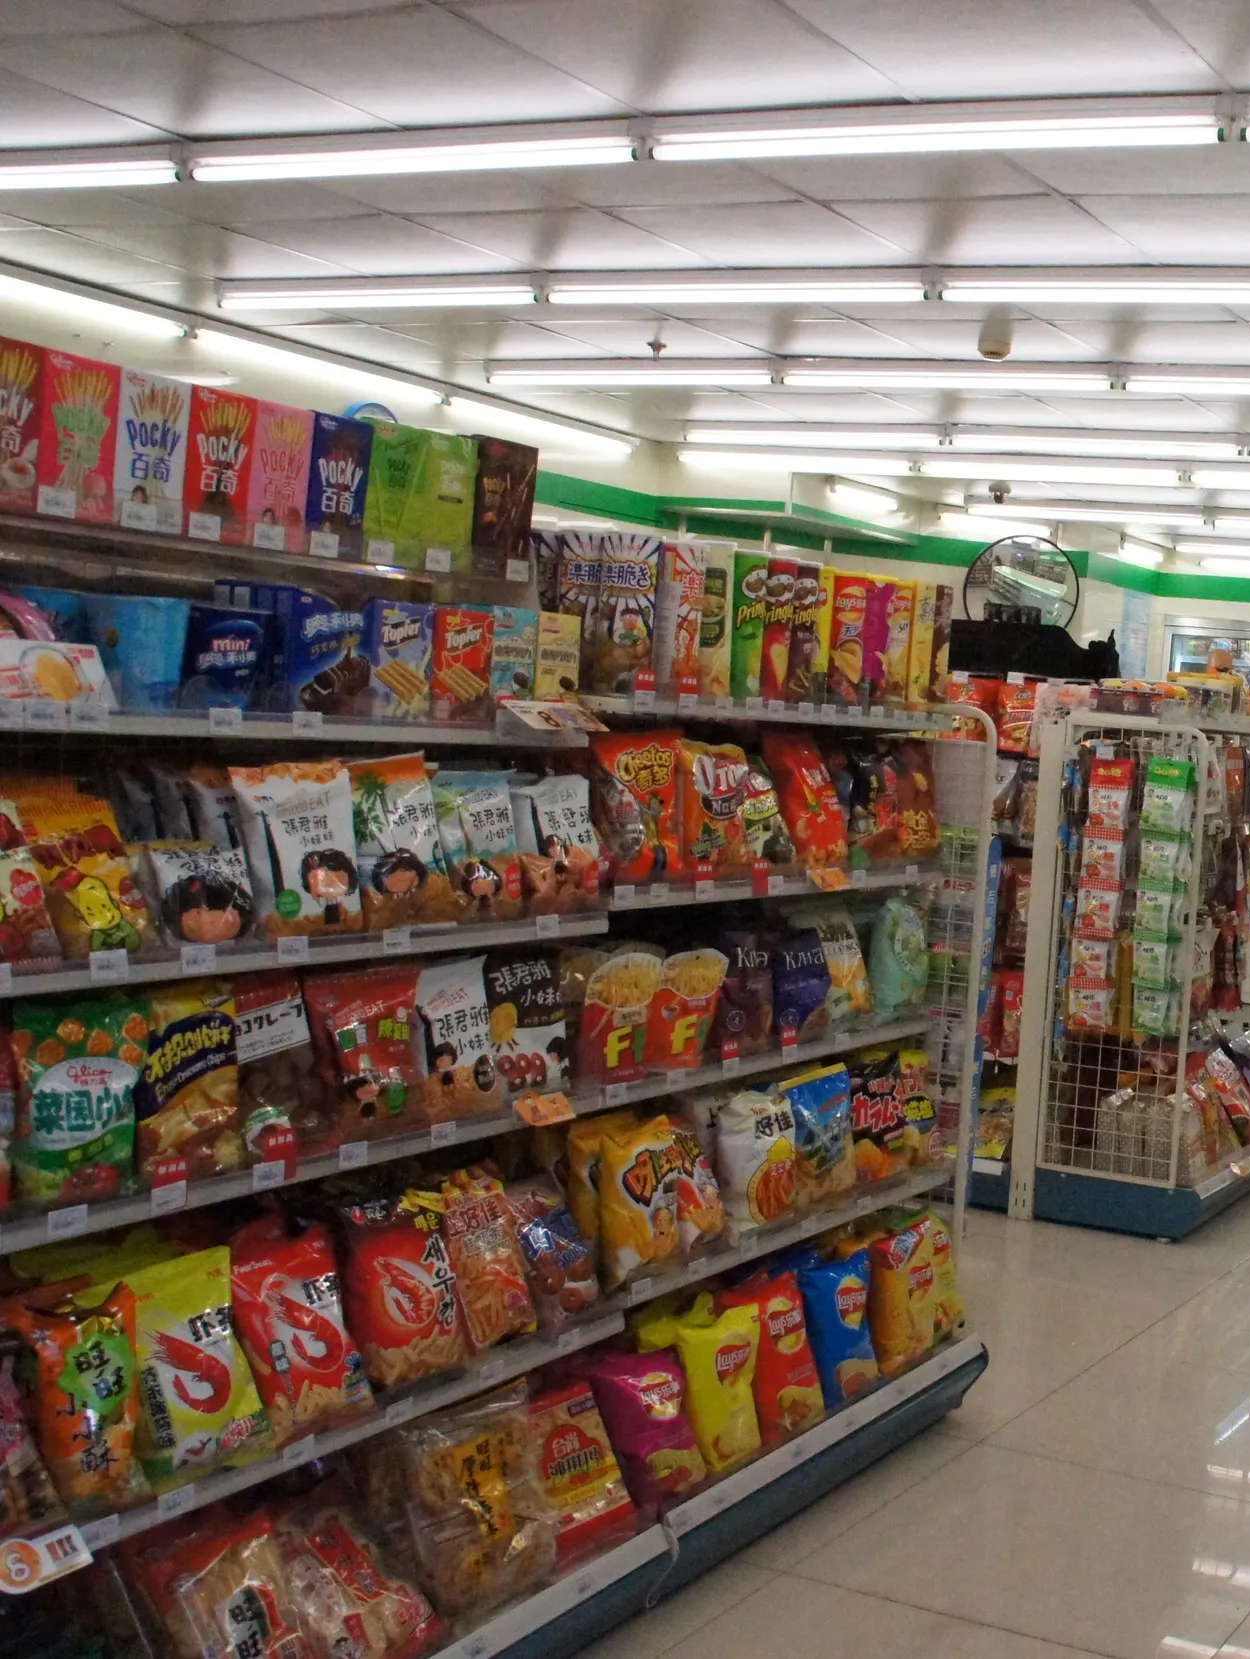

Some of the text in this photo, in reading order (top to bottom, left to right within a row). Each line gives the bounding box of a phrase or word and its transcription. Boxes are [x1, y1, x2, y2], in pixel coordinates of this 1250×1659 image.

[126, 418, 181, 457] POCKY
[196, 432, 248, 470] POCKY
[131, 451, 171, 483] 百奇
[260, 447, 304, 480] POCKY
[318, 456, 364, 491] POCKY
[200, 465, 239, 495] 百奇
[321, 486, 355, 515] 百奇
[304, 611, 365, 638] 奥利奥
[381, 619, 421, 644] Topfer
[445, 625, 489, 650] Topfer
[212, 637, 251, 652] mini
[617, 744, 674, 781] Cheetos
[635, 767, 671, 792] 奇多
[469, 807, 510, 831] 張君雅
[489, 958, 552, 995] 張君雅
[436, 1002, 490, 1041] 張君雅
[456, 1030, 491, 1056] 小妹
[66, 1065, 113, 1079] Glico
[421, 1232, 457, 1330] 새우깡
